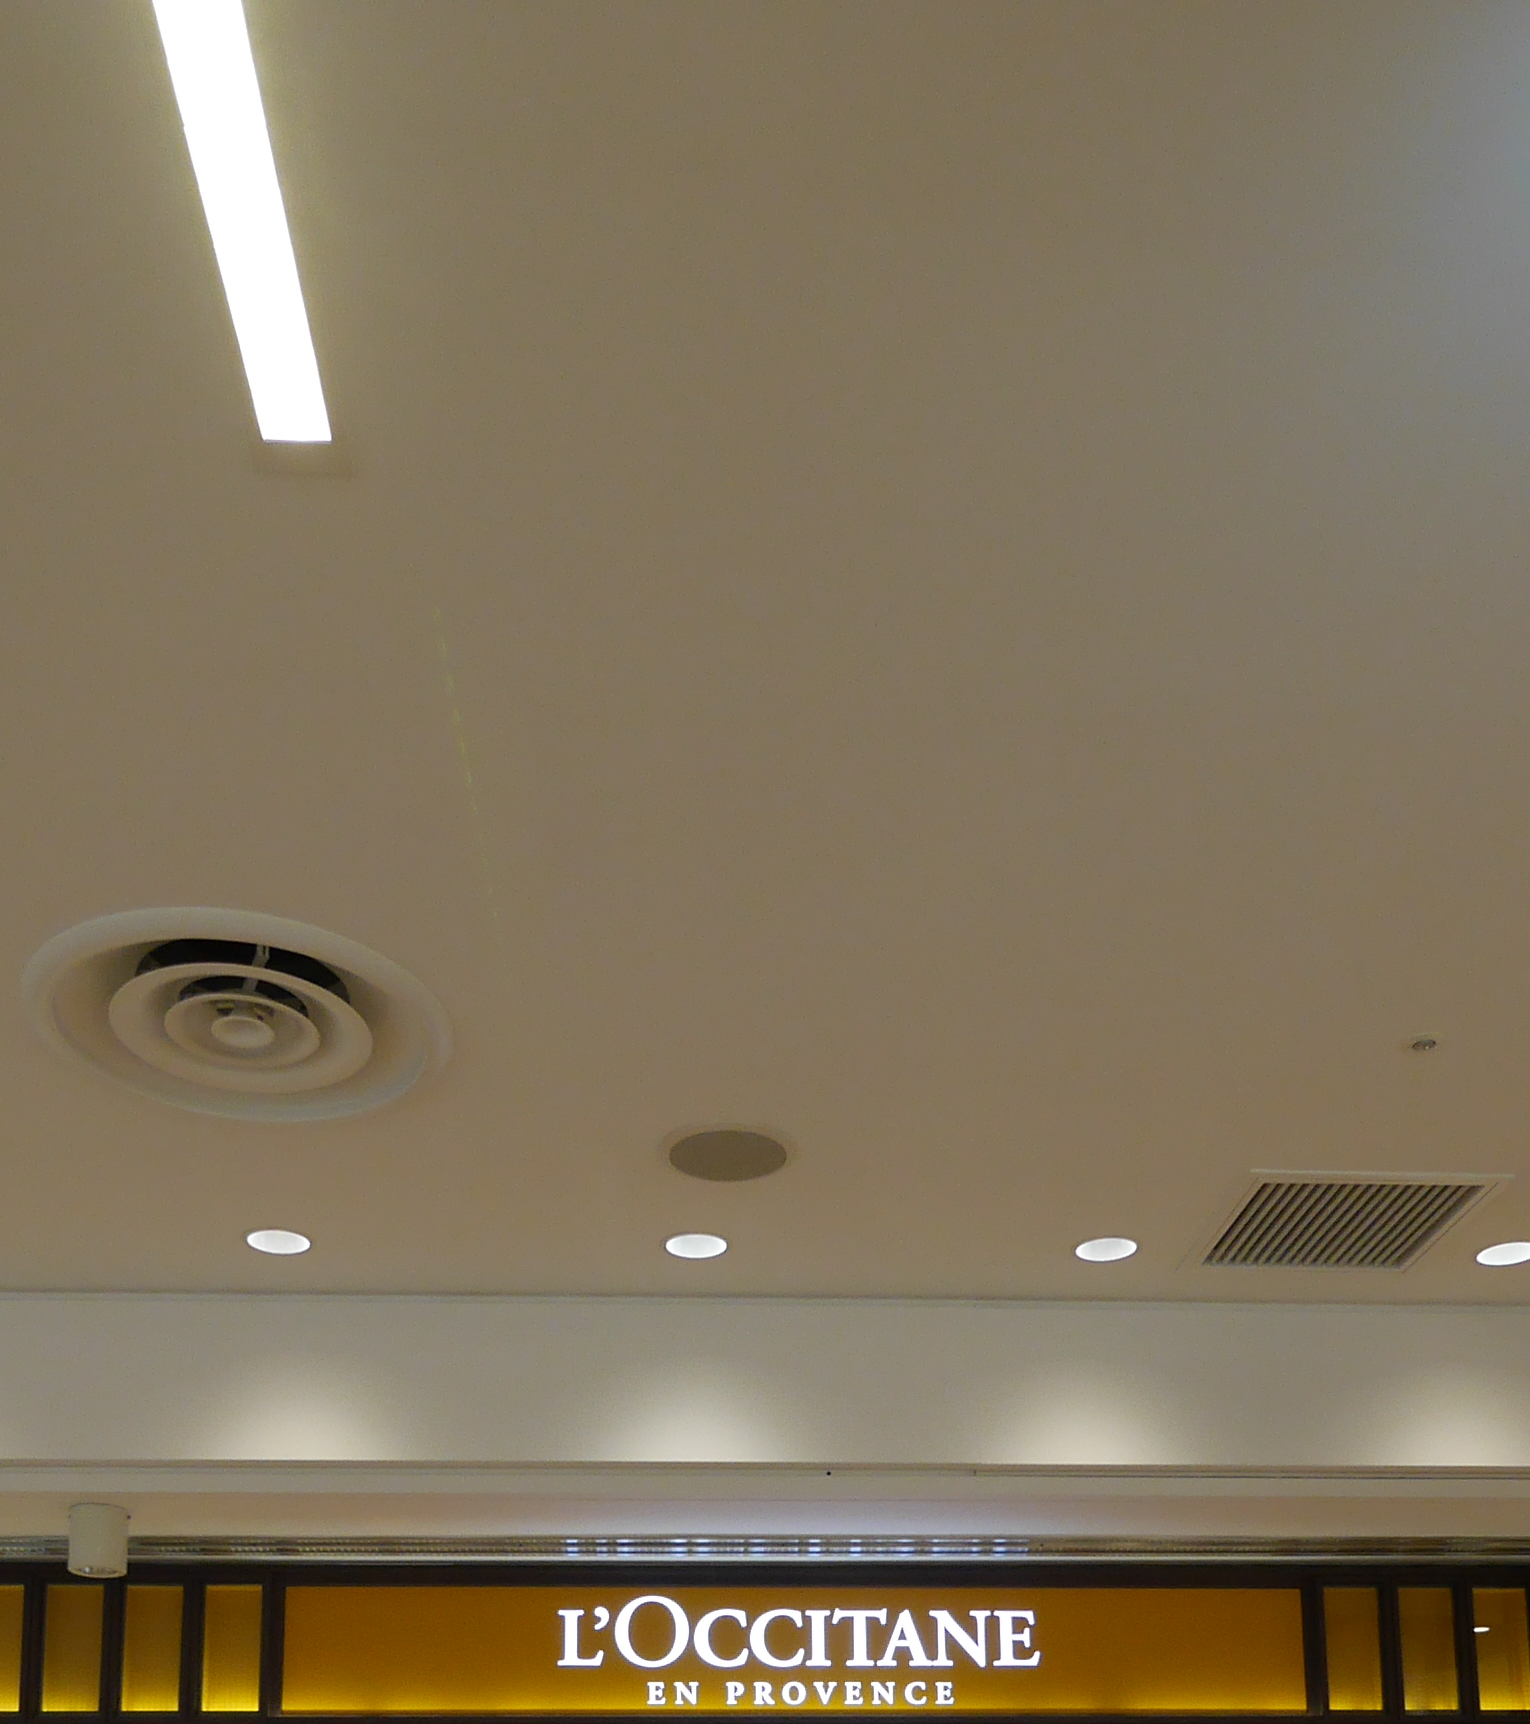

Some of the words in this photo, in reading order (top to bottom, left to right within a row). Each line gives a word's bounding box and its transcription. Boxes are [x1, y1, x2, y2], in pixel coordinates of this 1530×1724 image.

[556, 1595, 1041, 1669] L'OCCITANE
[646, 1680, 700, 1706] EN
[725, 1680, 956, 1706] PROVENCE
